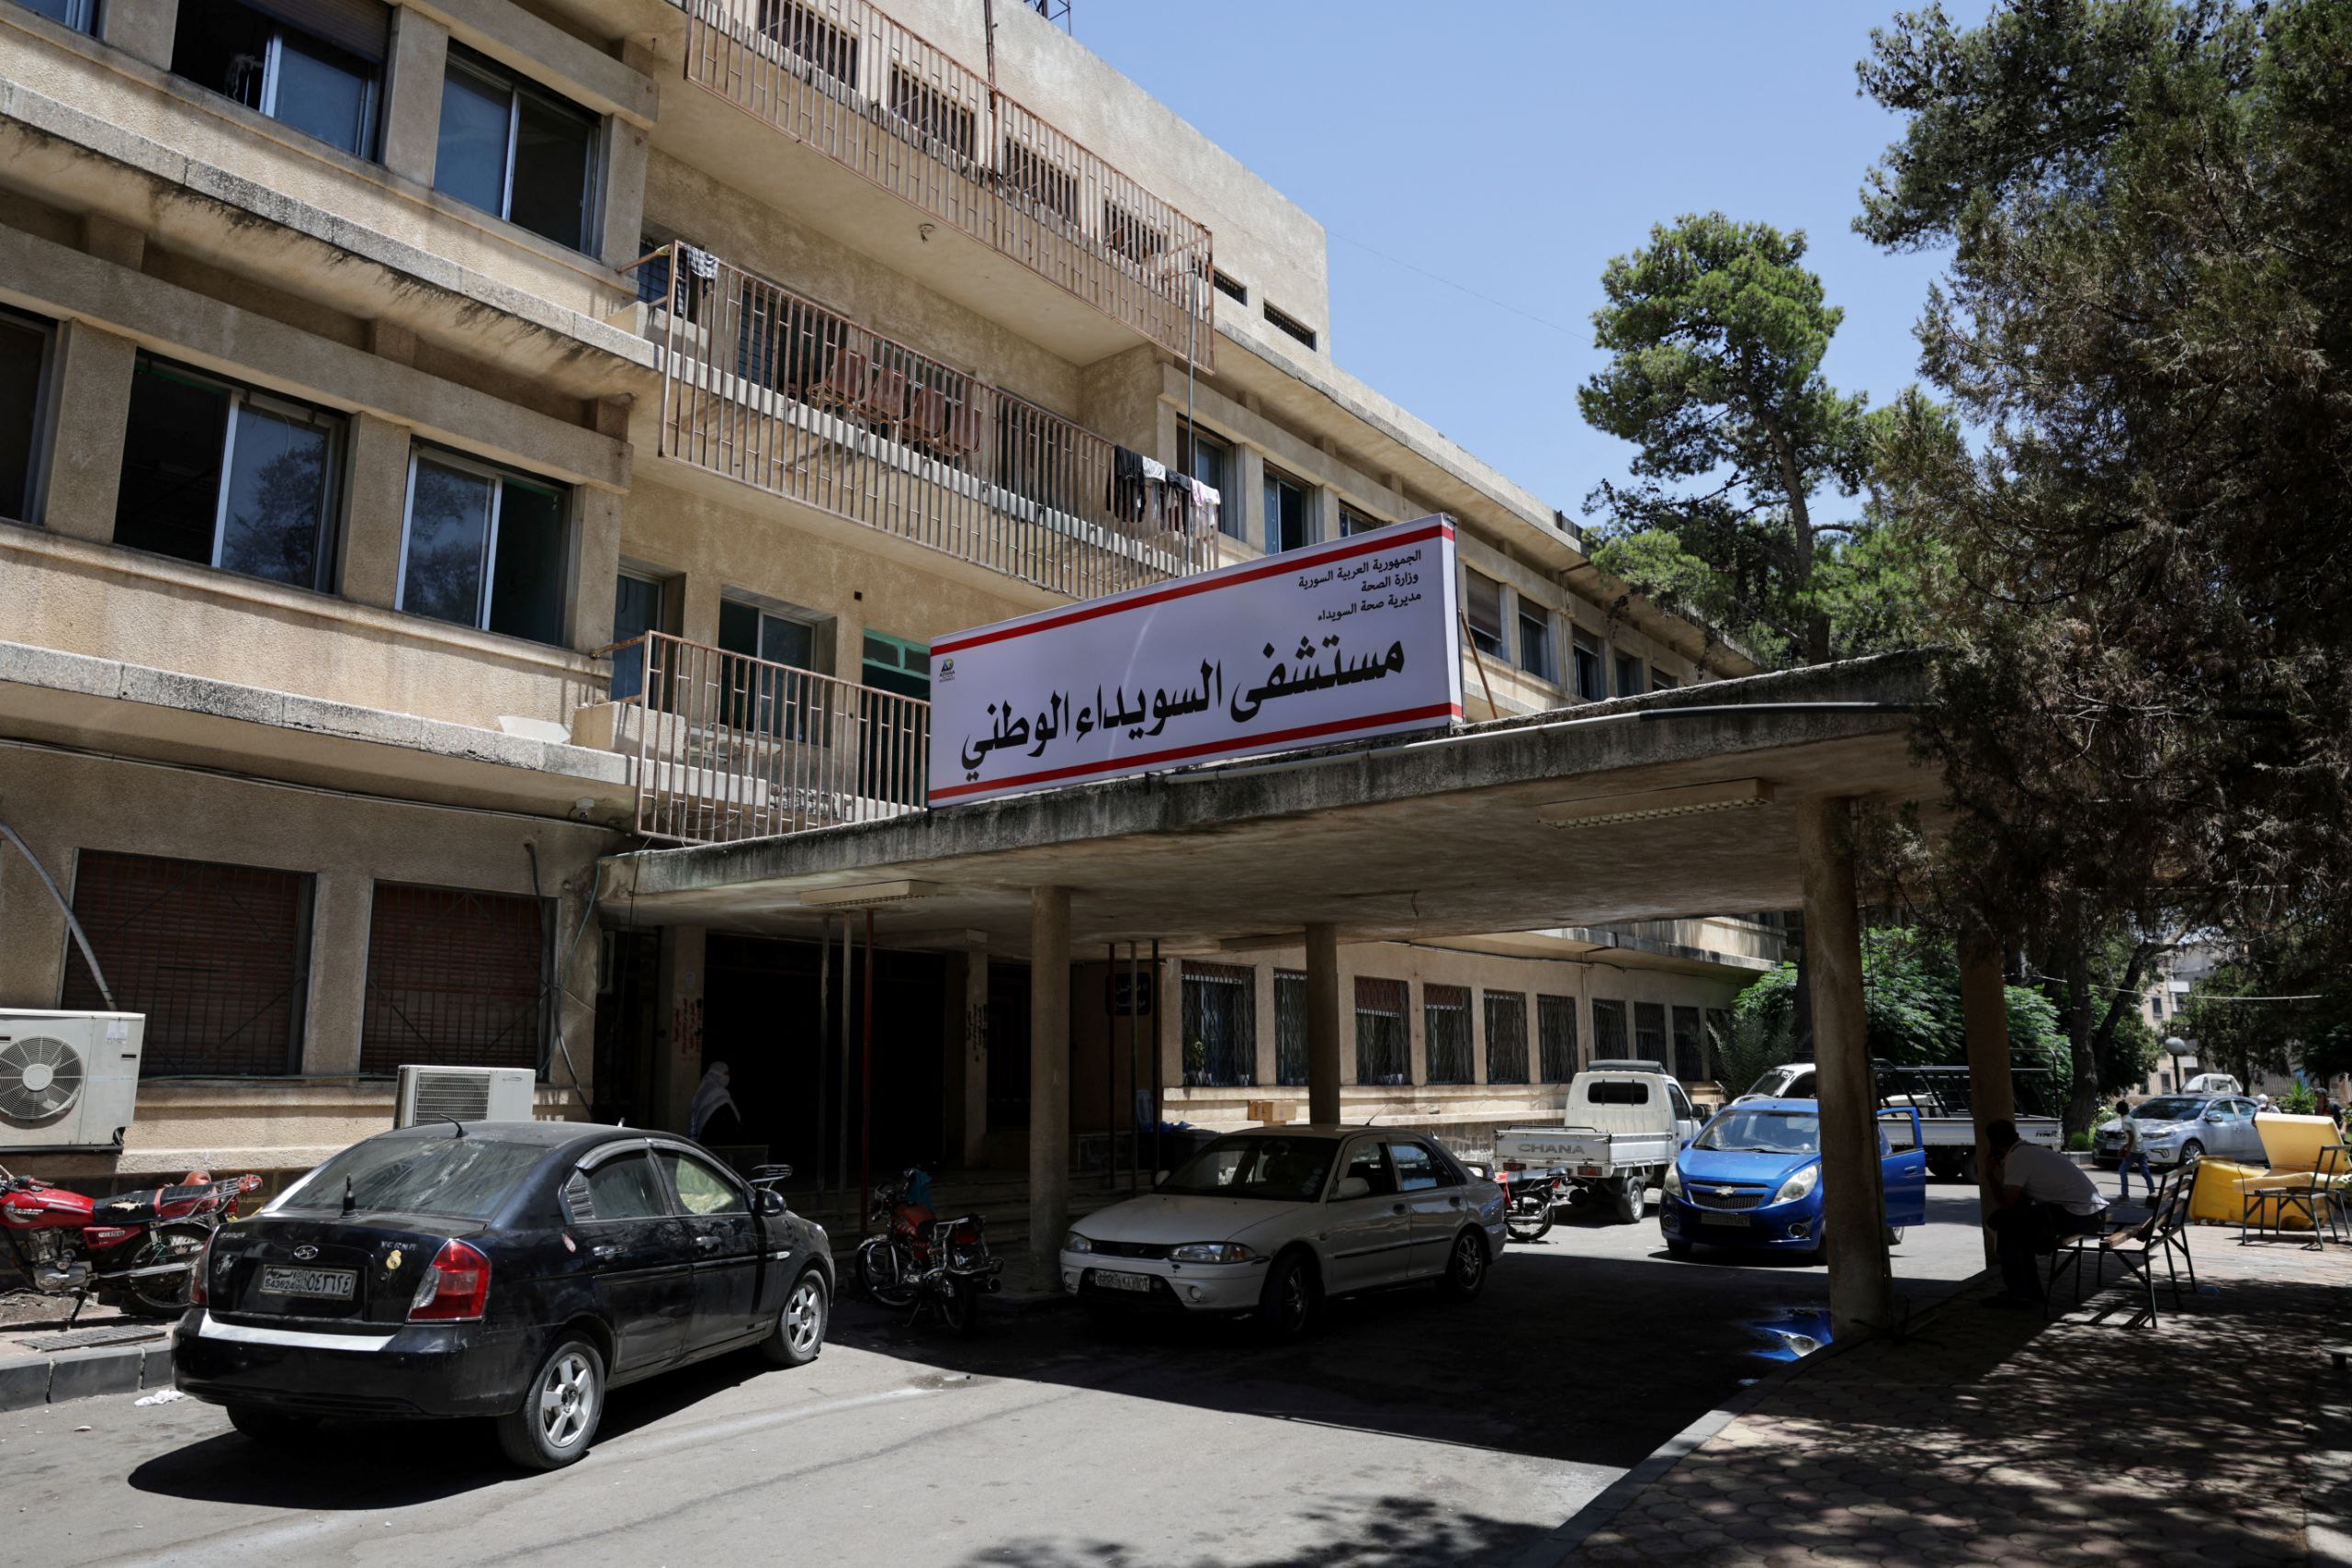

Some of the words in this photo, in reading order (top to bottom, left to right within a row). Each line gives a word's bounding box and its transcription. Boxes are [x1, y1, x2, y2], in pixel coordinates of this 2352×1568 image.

[1373, 549, 1421, 573] الجمهورية
[1298, 570, 1333, 590] السورية
[1337, 561, 1369, 581] العربية
[1395, 571, 1419, 588] وزارة
[1362, 575, 1391, 592] الصحة
[1360, 600, 1385, 612] صحة
[1387, 592, 1421, 609] مديرية
[1317, 603, 1357, 622] السويداء
[1230, 634, 1406, 724] مستشفى
[1076, 658, 1223, 744] السويداء
[961, 691, 1069, 783] الوطني
[1518, 1143, 1585, 1155] CHANA
